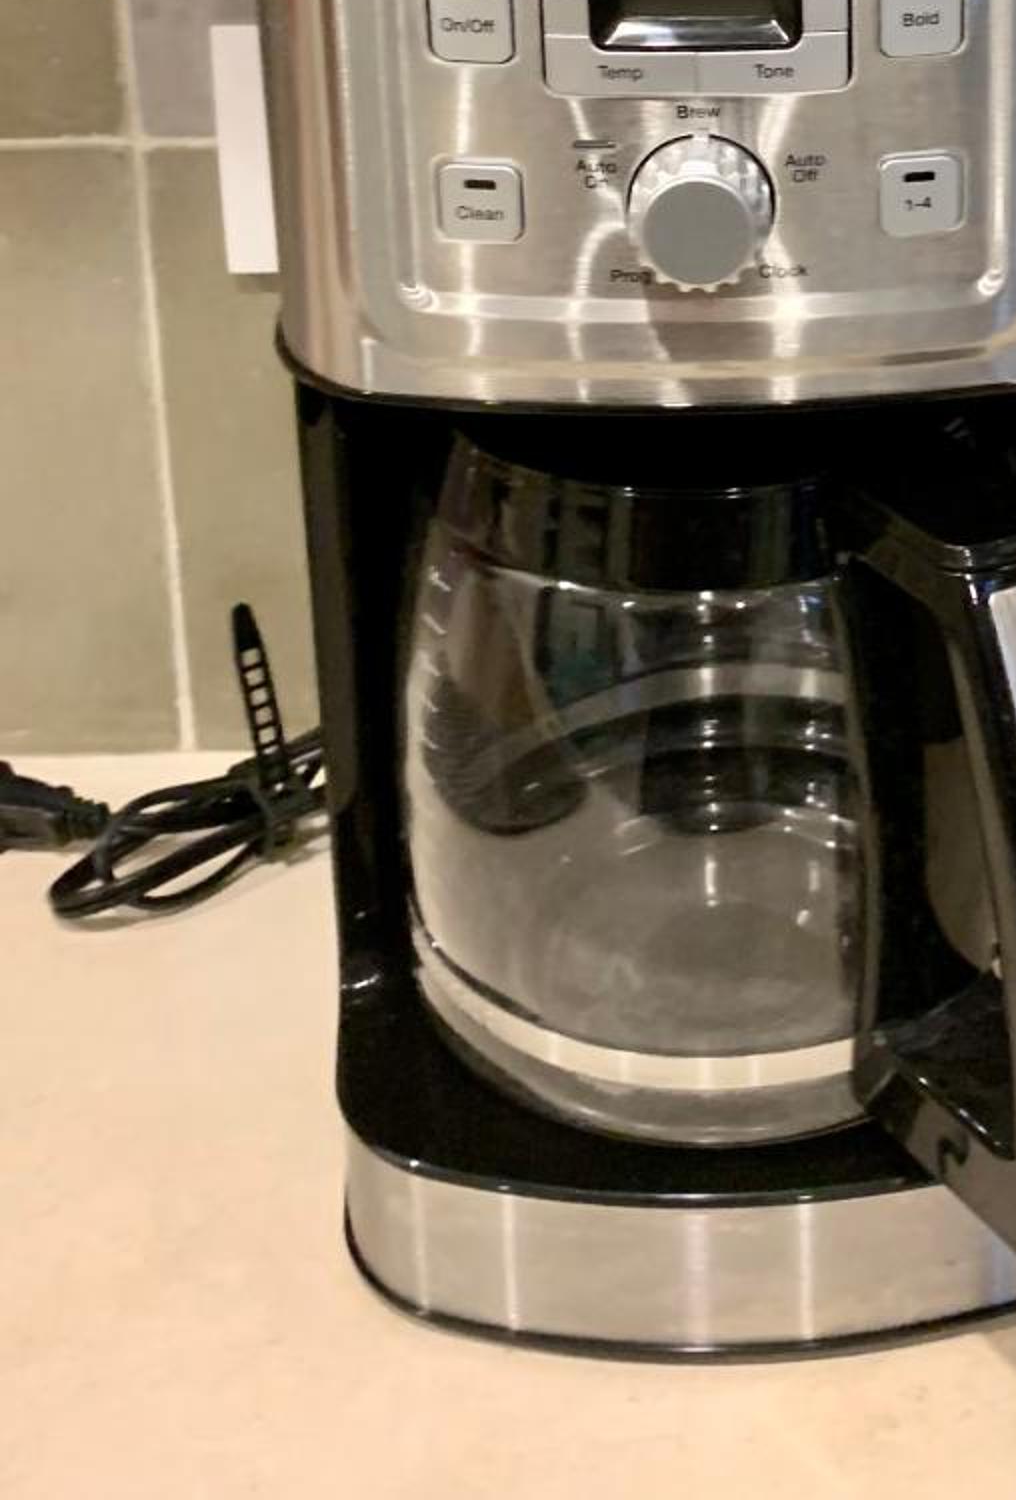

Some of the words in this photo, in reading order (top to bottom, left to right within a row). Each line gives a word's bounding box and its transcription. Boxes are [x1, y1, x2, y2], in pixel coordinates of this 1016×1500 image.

[441, 16, 495, 34] On/Off
[902, 11, 940, 28] Bold
[599, 66, 644, 83] Temp
[754, 64, 794, 80] Tone
[676, 105, 721, 120] Brew
[576, 160, 617, 175] Auto
[785, 153, 826, 168] Auto
[792, 169, 818, 183] Off
[455, 205, 505, 222] Clean
[759, 263, 808, 279] Clock
